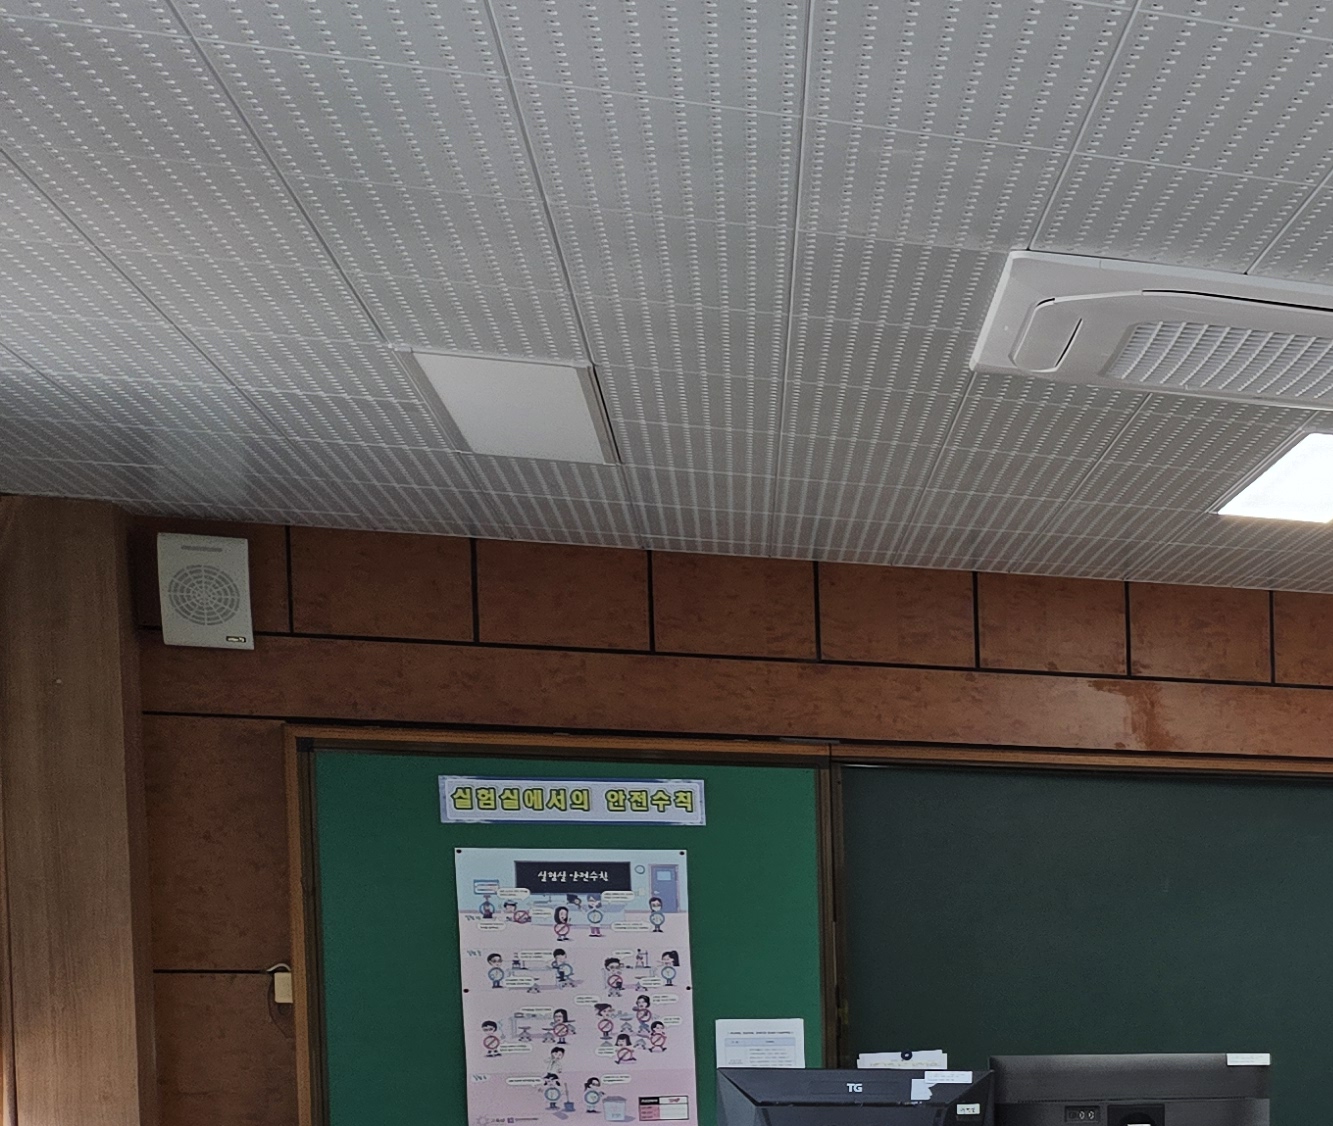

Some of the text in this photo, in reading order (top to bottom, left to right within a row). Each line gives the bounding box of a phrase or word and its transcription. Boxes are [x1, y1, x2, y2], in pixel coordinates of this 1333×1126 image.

[453, 786, 694, 812] 실험실에서의 안전수칙
[537, 871, 608, 882] 실험실 안전수칙
[847, 1083, 862, 1092] TG
